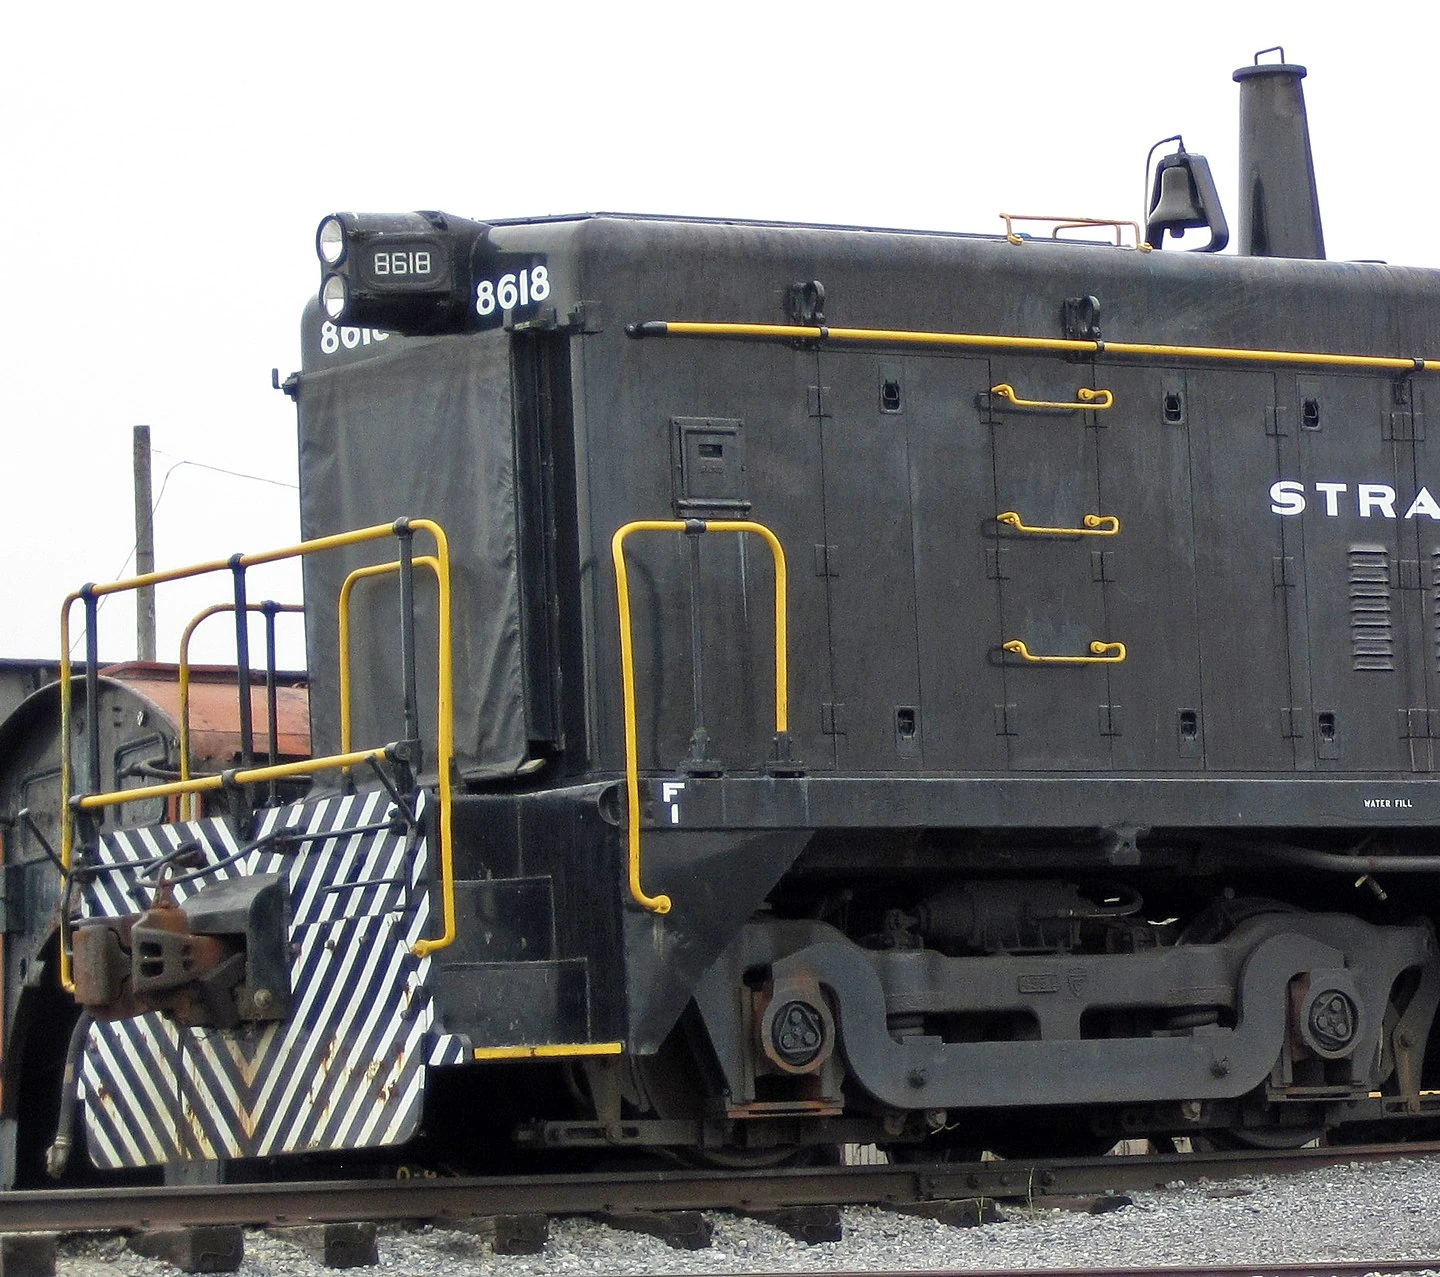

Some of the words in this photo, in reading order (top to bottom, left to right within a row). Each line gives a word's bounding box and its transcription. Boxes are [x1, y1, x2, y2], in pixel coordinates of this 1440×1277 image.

[374, 251, 431, 275] 8618
[476, 265, 551, 316] 8618
[662, 782, 685, 802] F
[1363, 799, 1391, 808] WATER
[1394, 799, 1413, 808] FILL
